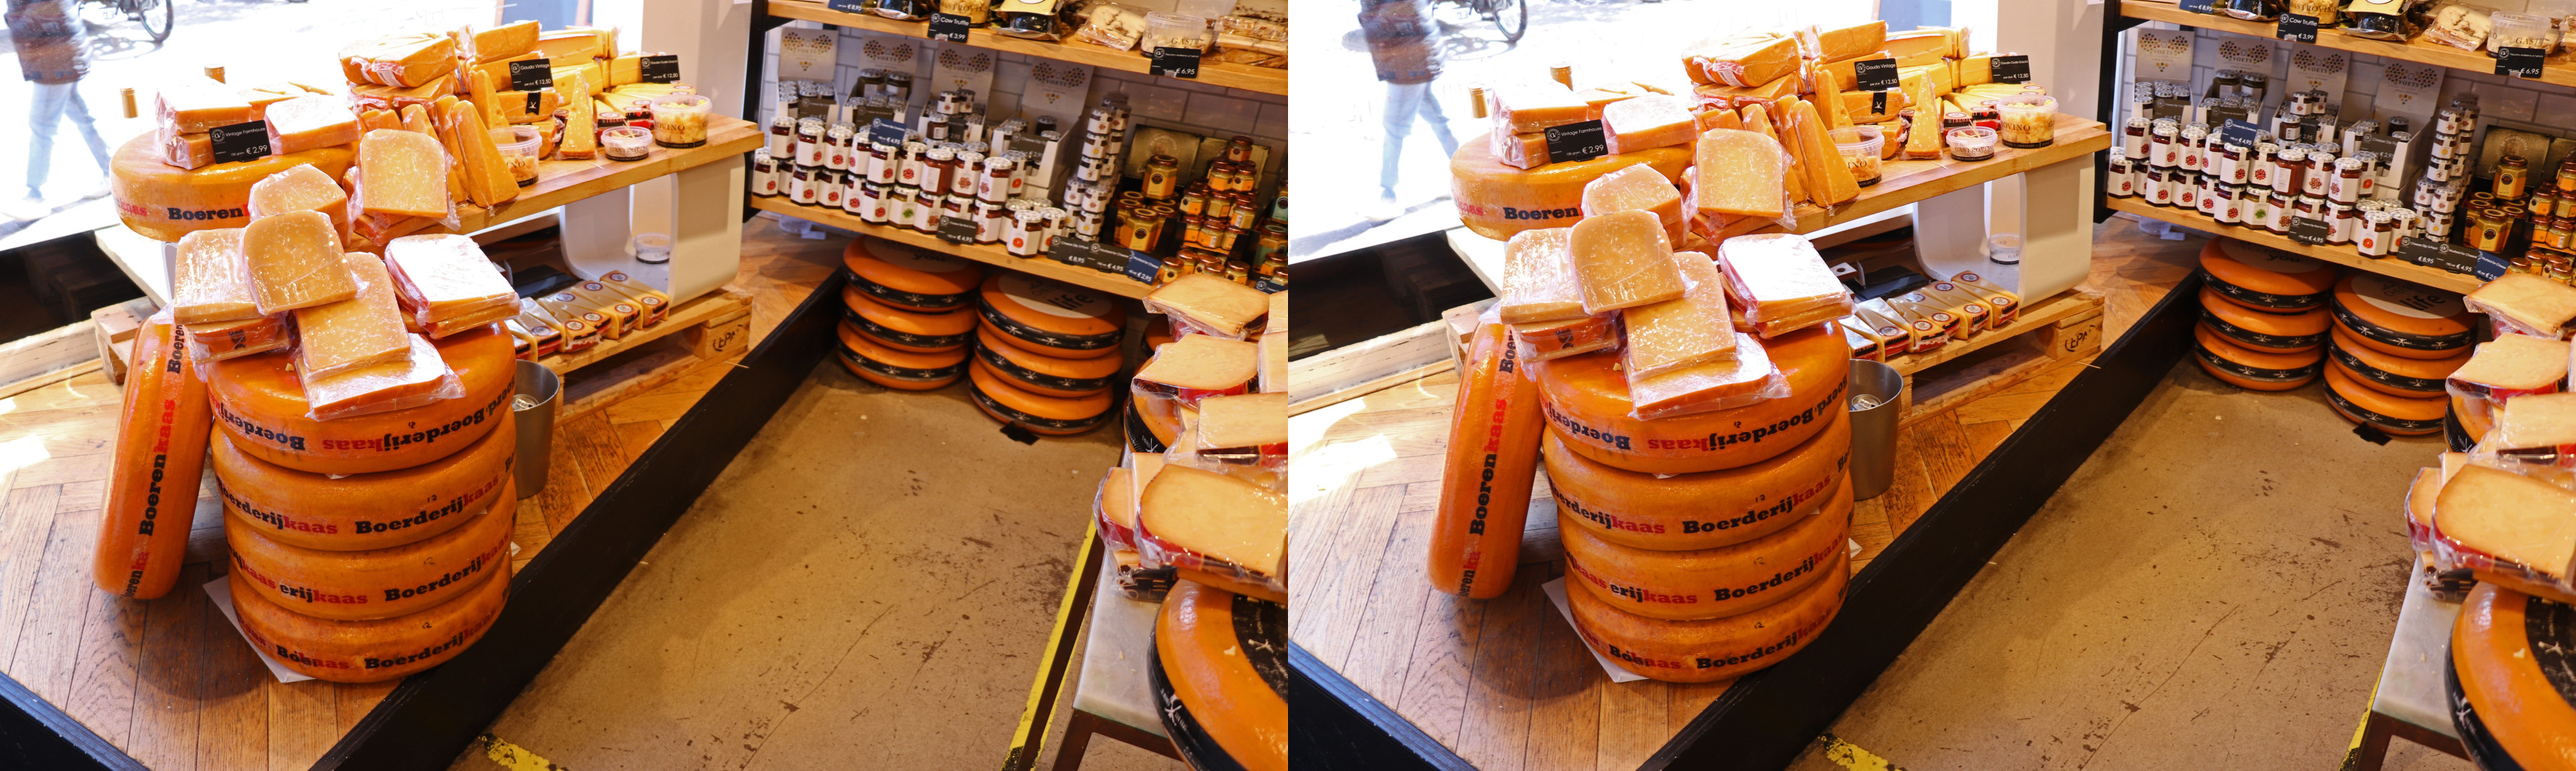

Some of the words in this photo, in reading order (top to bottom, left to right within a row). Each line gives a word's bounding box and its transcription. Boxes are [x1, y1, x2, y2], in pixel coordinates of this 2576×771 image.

[252, 145, 268, 153] 2,99
[1588, 144, 1604, 153] 2,99
[1142, 273, 1152, 282] 2,95
[2266, 253, 2301, 263] you
[1047, 294, 1095, 311] life
[2399, 295, 2446, 311] life
[323, 409, 485, 453] Boerderijkaas
[1648, 406, 1815, 452] Boerderijkaas
[139, 399, 176, 537] Boerenkaas
[1470, 398, 1507, 536] Boerenkaas
[355, 473, 501, 535] Boerderijkaas
[1683, 474, 1831, 535] Boerderijkaas
[384, 530, 509, 603] Boerderijkaas
[1714, 531, 1845, 602] Boerderijkaas
[280, 583, 368, 605] erijkaas
[1610, 584, 1698, 605] erijkaas
[364, 608, 497, 670] Boerderijkaas
[1696, 608, 1832, 670] Boerderijkaas
